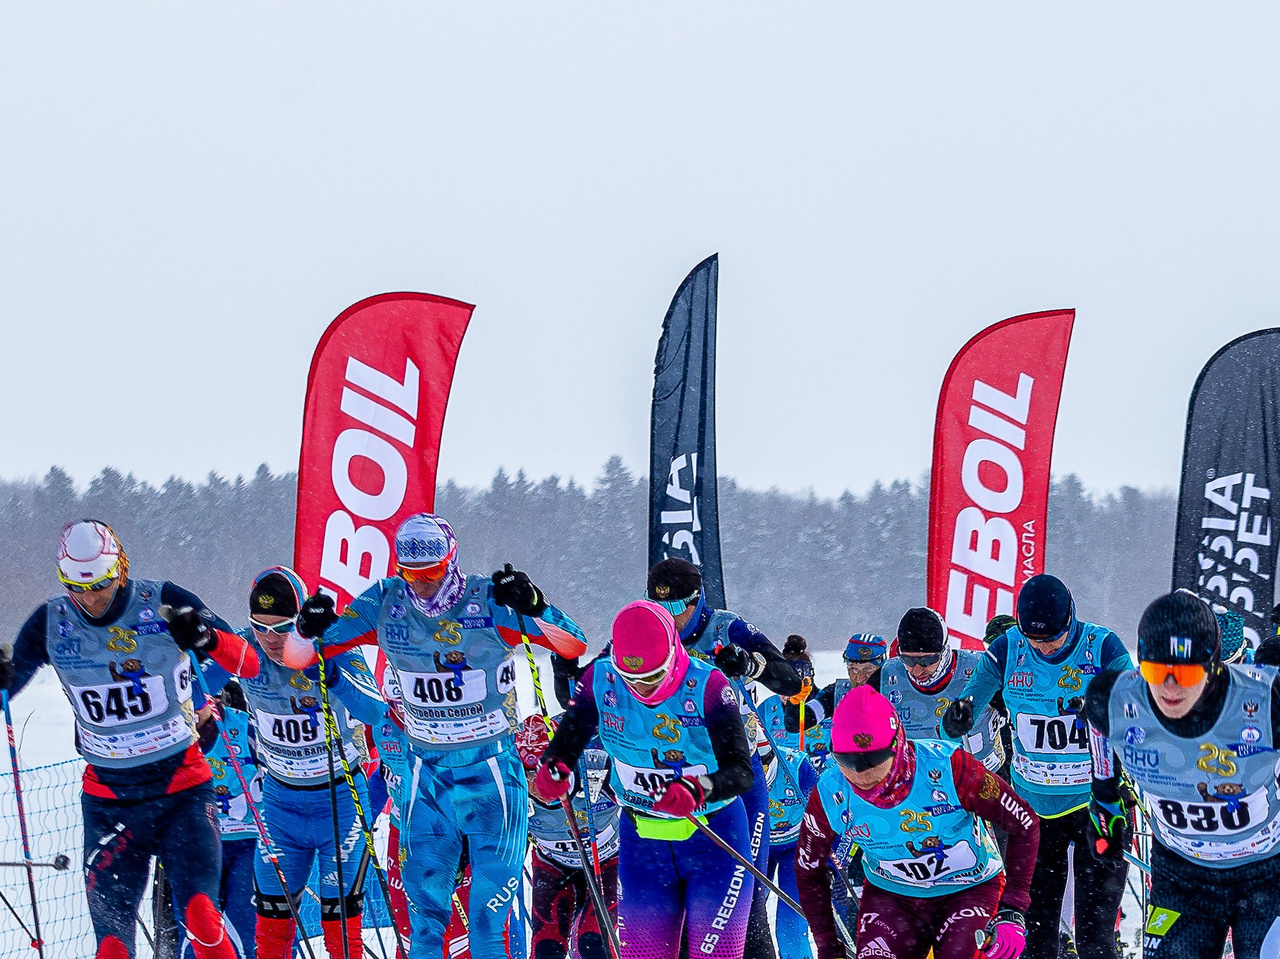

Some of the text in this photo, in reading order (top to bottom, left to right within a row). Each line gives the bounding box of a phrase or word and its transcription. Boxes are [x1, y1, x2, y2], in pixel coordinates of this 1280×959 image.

[319, 356, 420, 613] BOIL
[945, 371, 1035, 650] EBOIL
[1198, 471, 1243, 600] SSIA
[81, 683, 152, 724] 645
[413, 677, 463, 703] 408
[272, 718, 318, 744] 409
[1030, 718, 1088, 750] 704
[1197, 743, 1238, 777] 25
[900, 809, 932, 832] 25
[1157, 799, 1250, 832] 830
[486, 876, 520, 914] RUS
[700, 864, 746, 955] 65 REGION
[936, 907, 991, 942] LUKOIL
[858, 947, 897, 959] adidas
